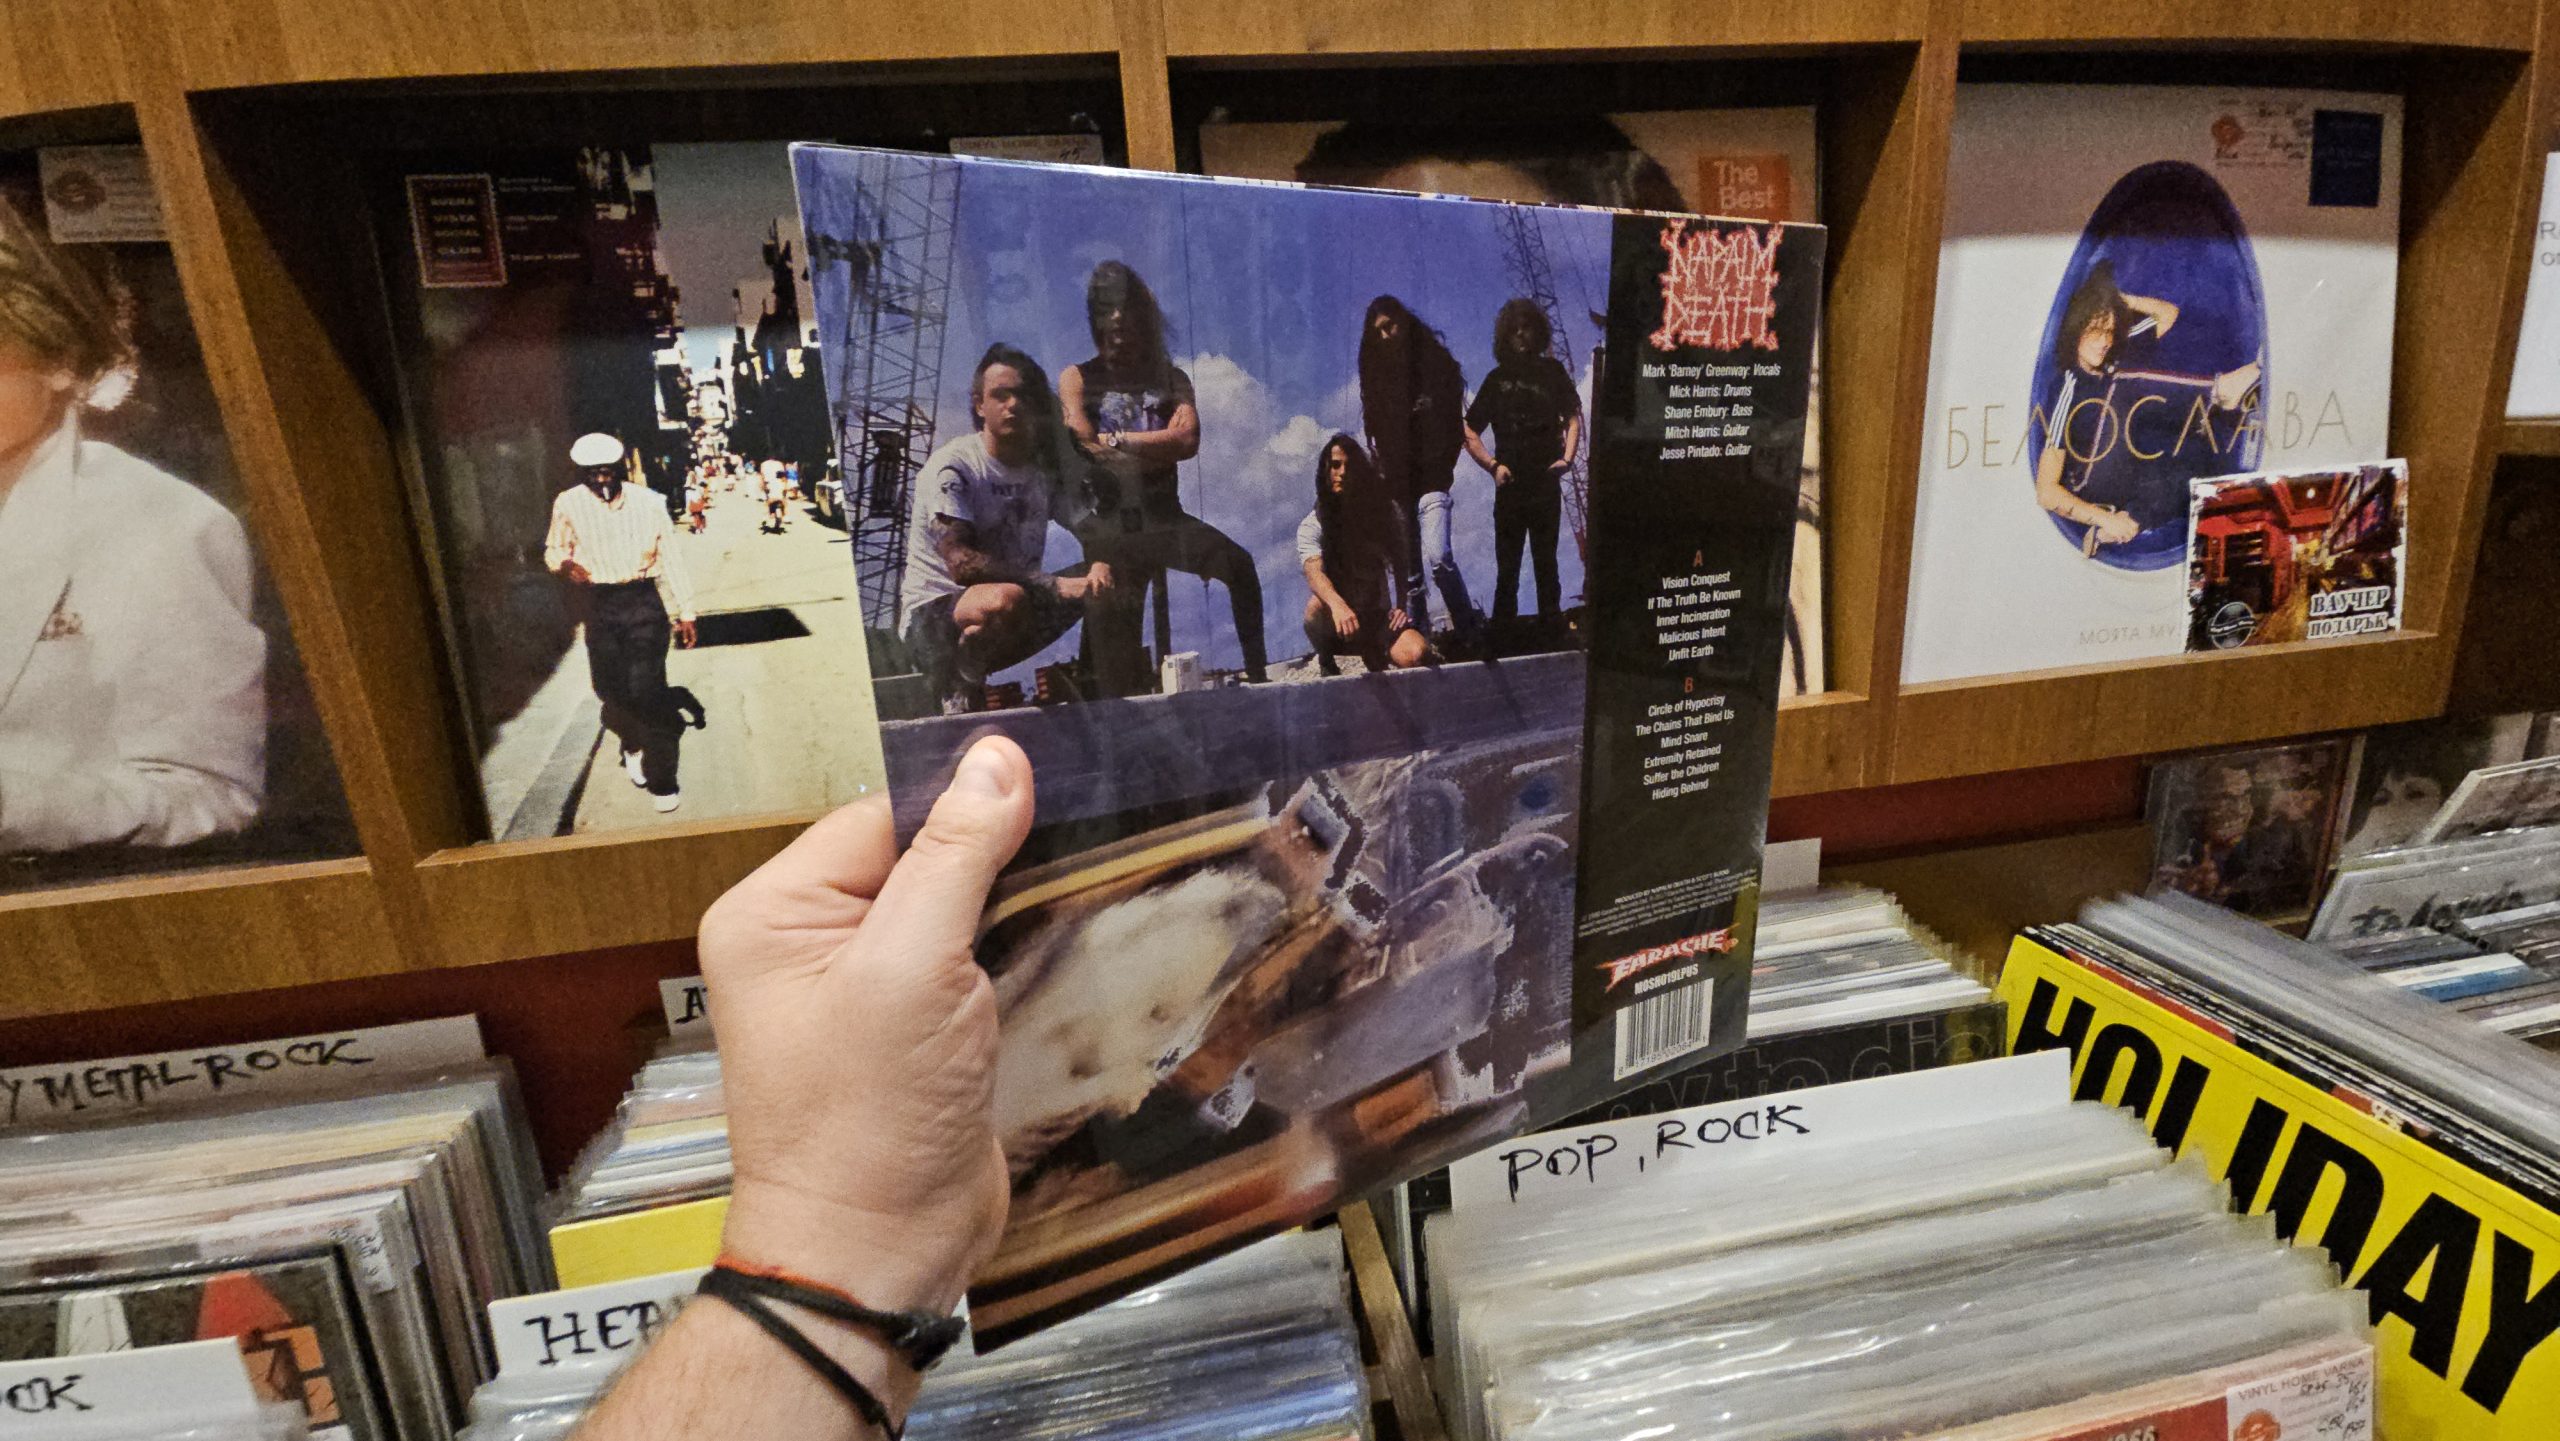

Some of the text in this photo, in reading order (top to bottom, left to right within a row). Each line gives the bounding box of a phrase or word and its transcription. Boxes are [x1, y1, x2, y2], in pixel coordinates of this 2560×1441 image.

[1713, 160, 1759, 186] The
[1719, 184, 1774, 210] Best
[1659, 219, 1783, 289] NAPALM
[1650, 285, 1779, 350] DEATH
[1642, 364, 1666, 377] Mark
[1753, 363, 1781, 376] Vocals
[1669, 384, 1752, 398] Mick Harris: Drums
[1664, 406, 1692, 419] Shane
[1731, 404, 1753, 416] Bass
[1665, 424, 1750, 439] Mitch Harris: Guitar
[1946, 390, 2352, 470] БЕЛОСЛАВА
[1659, 444, 1752, 460] Jesse Pintado: Guitar
[1693, 550, 1703, 567] A
[1662, 571, 1731, 589] Vision Conquest
[1648, 589, 1741, 610] If The Truth Be Known
[2311, 587, 2389, 613] ВАУЧЕР
[1656, 608, 1731, 627] Inner Incineration
[2308, 613, 2387, 638] ПОДАРЪК
[1659, 625, 1726, 644] Malicious Intent
[1669, 644, 1714, 661] Unfit Earth
[1684, 677, 1693, 693] B
[1648, 695, 1726, 717] Circle of Hypocrisy
[1636, 709, 1735, 736] The Chains That Bind Us
[1661, 732, 1708, 748] Mind Snare
[1644, 744, 1721, 768] Extremity Retained
[1643, 762, 1720, 785] Suffer the Children
[1652, 786, 1679, 800] Hiding
[1600, 925, 1736, 993] EARACHE
[675, 986, 707, 1024] A
[33, 1062, 197, 1111] METAL
[193, 1038, 374, 1089] ROCK
[1656, 1104, 1811, 1160] ROCK
[524, 1298, 682, 1366] HEA
[0, 1375, 94, 1413] CK
[2238, 1383, 2278, 1401] VINYL
[2282, 1371, 2319, 1388] HOME
